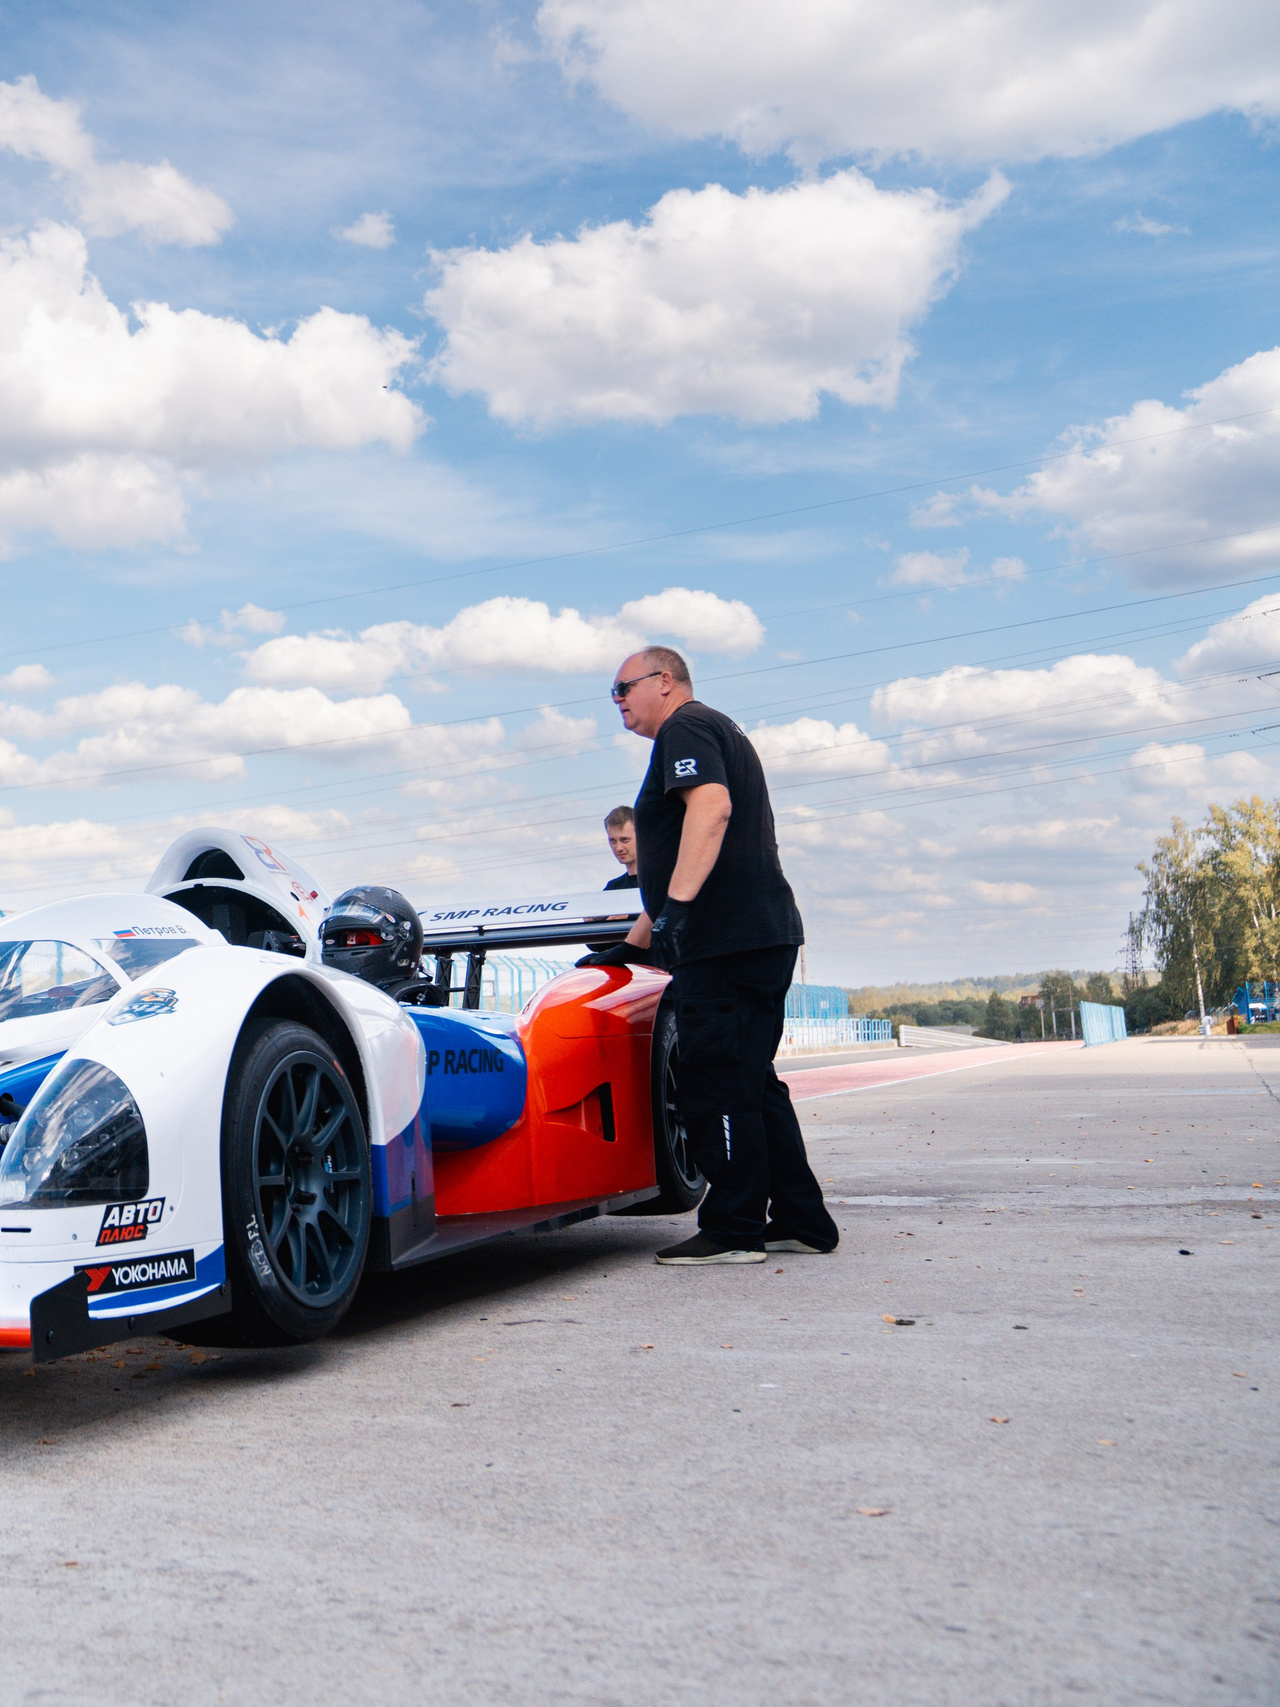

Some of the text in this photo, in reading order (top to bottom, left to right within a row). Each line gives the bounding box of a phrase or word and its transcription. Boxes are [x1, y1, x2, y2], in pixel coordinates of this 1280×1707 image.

[429, 901, 569, 922] SMP RACING
[131, 926, 177, 936] Петров
[443, 1049, 504, 1075] RACING
[103, 1200, 162, 1228] АВТО
[99, 1224, 145, 1244] ПЛЮС
[111, 1257, 188, 1285] YOKOHAMA
